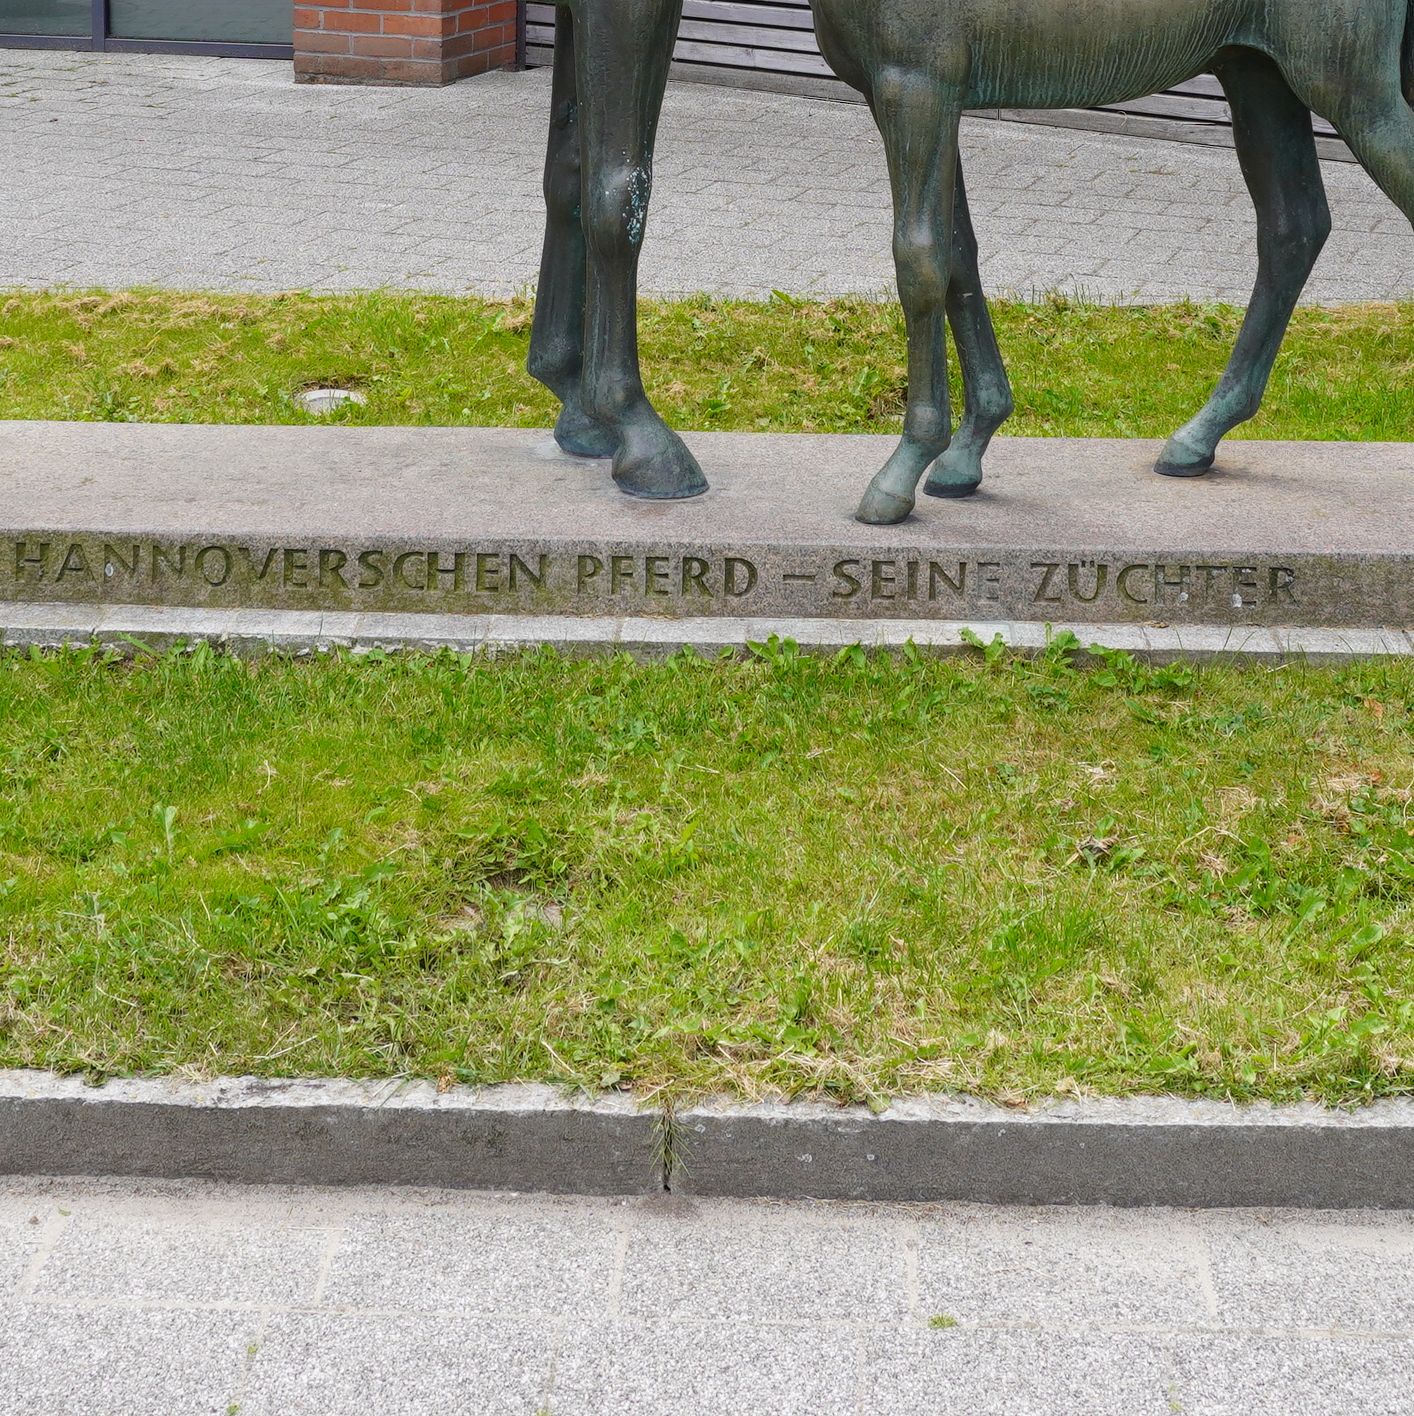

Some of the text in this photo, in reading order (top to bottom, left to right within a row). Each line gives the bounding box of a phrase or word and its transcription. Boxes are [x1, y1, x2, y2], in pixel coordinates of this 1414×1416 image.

[14, 541, 549, 595] HANNOVERSCHEN
[577, 554, 760, 598] PFERD
[833, 559, 1002, 602] SEINE
[1029, 559, 1299, 607] ZÜCHTER
